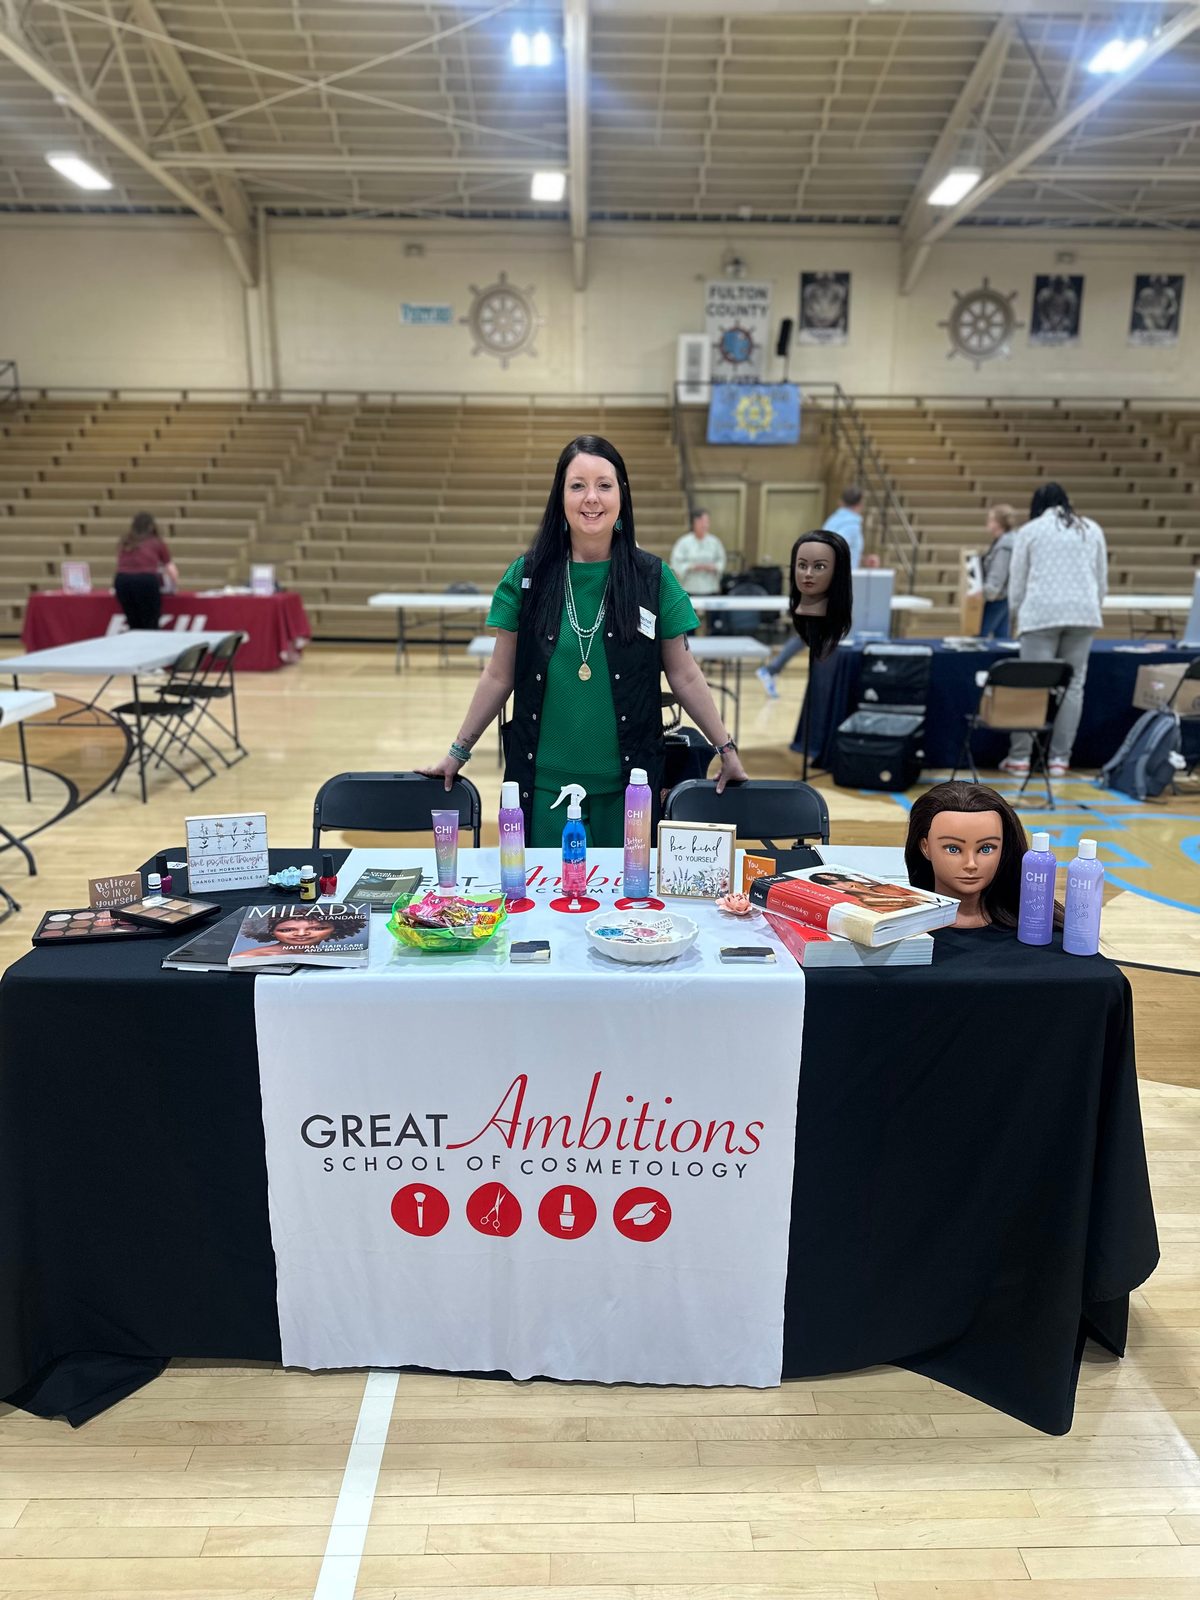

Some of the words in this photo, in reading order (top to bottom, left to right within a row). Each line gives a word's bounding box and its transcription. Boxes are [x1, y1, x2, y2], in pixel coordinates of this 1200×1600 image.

[709, 285, 769, 299] FULTON
[706, 303, 769, 317] COUNTY
[626, 809, 643, 819] CHI
[434, 825, 453, 834] CHI
[503, 823, 521, 832] CHI
[670, 835, 687, 852] be
[691, 835, 722, 857] kind
[685, 855, 717, 863] YOURSELF
[747, 860, 758, 869] You
[756, 868, 768, 876] are
[1026, 872, 1047, 883] CHI
[1070, 878, 1091, 890] CHI
[95, 879, 136, 893] Believe
[112, 889, 121, 898] IN
[96, 894, 138, 908] yourself
[248, 903, 366, 918] MILADY
[301, 1113, 448, 1149] GREAT
[446, 1071, 764, 1155] Ambitions
[324, 1156, 445, 1172] SCHOOL
[466, 1155, 502, 1171] OF
[520, 1157, 748, 1178] COSMETOLOGY
